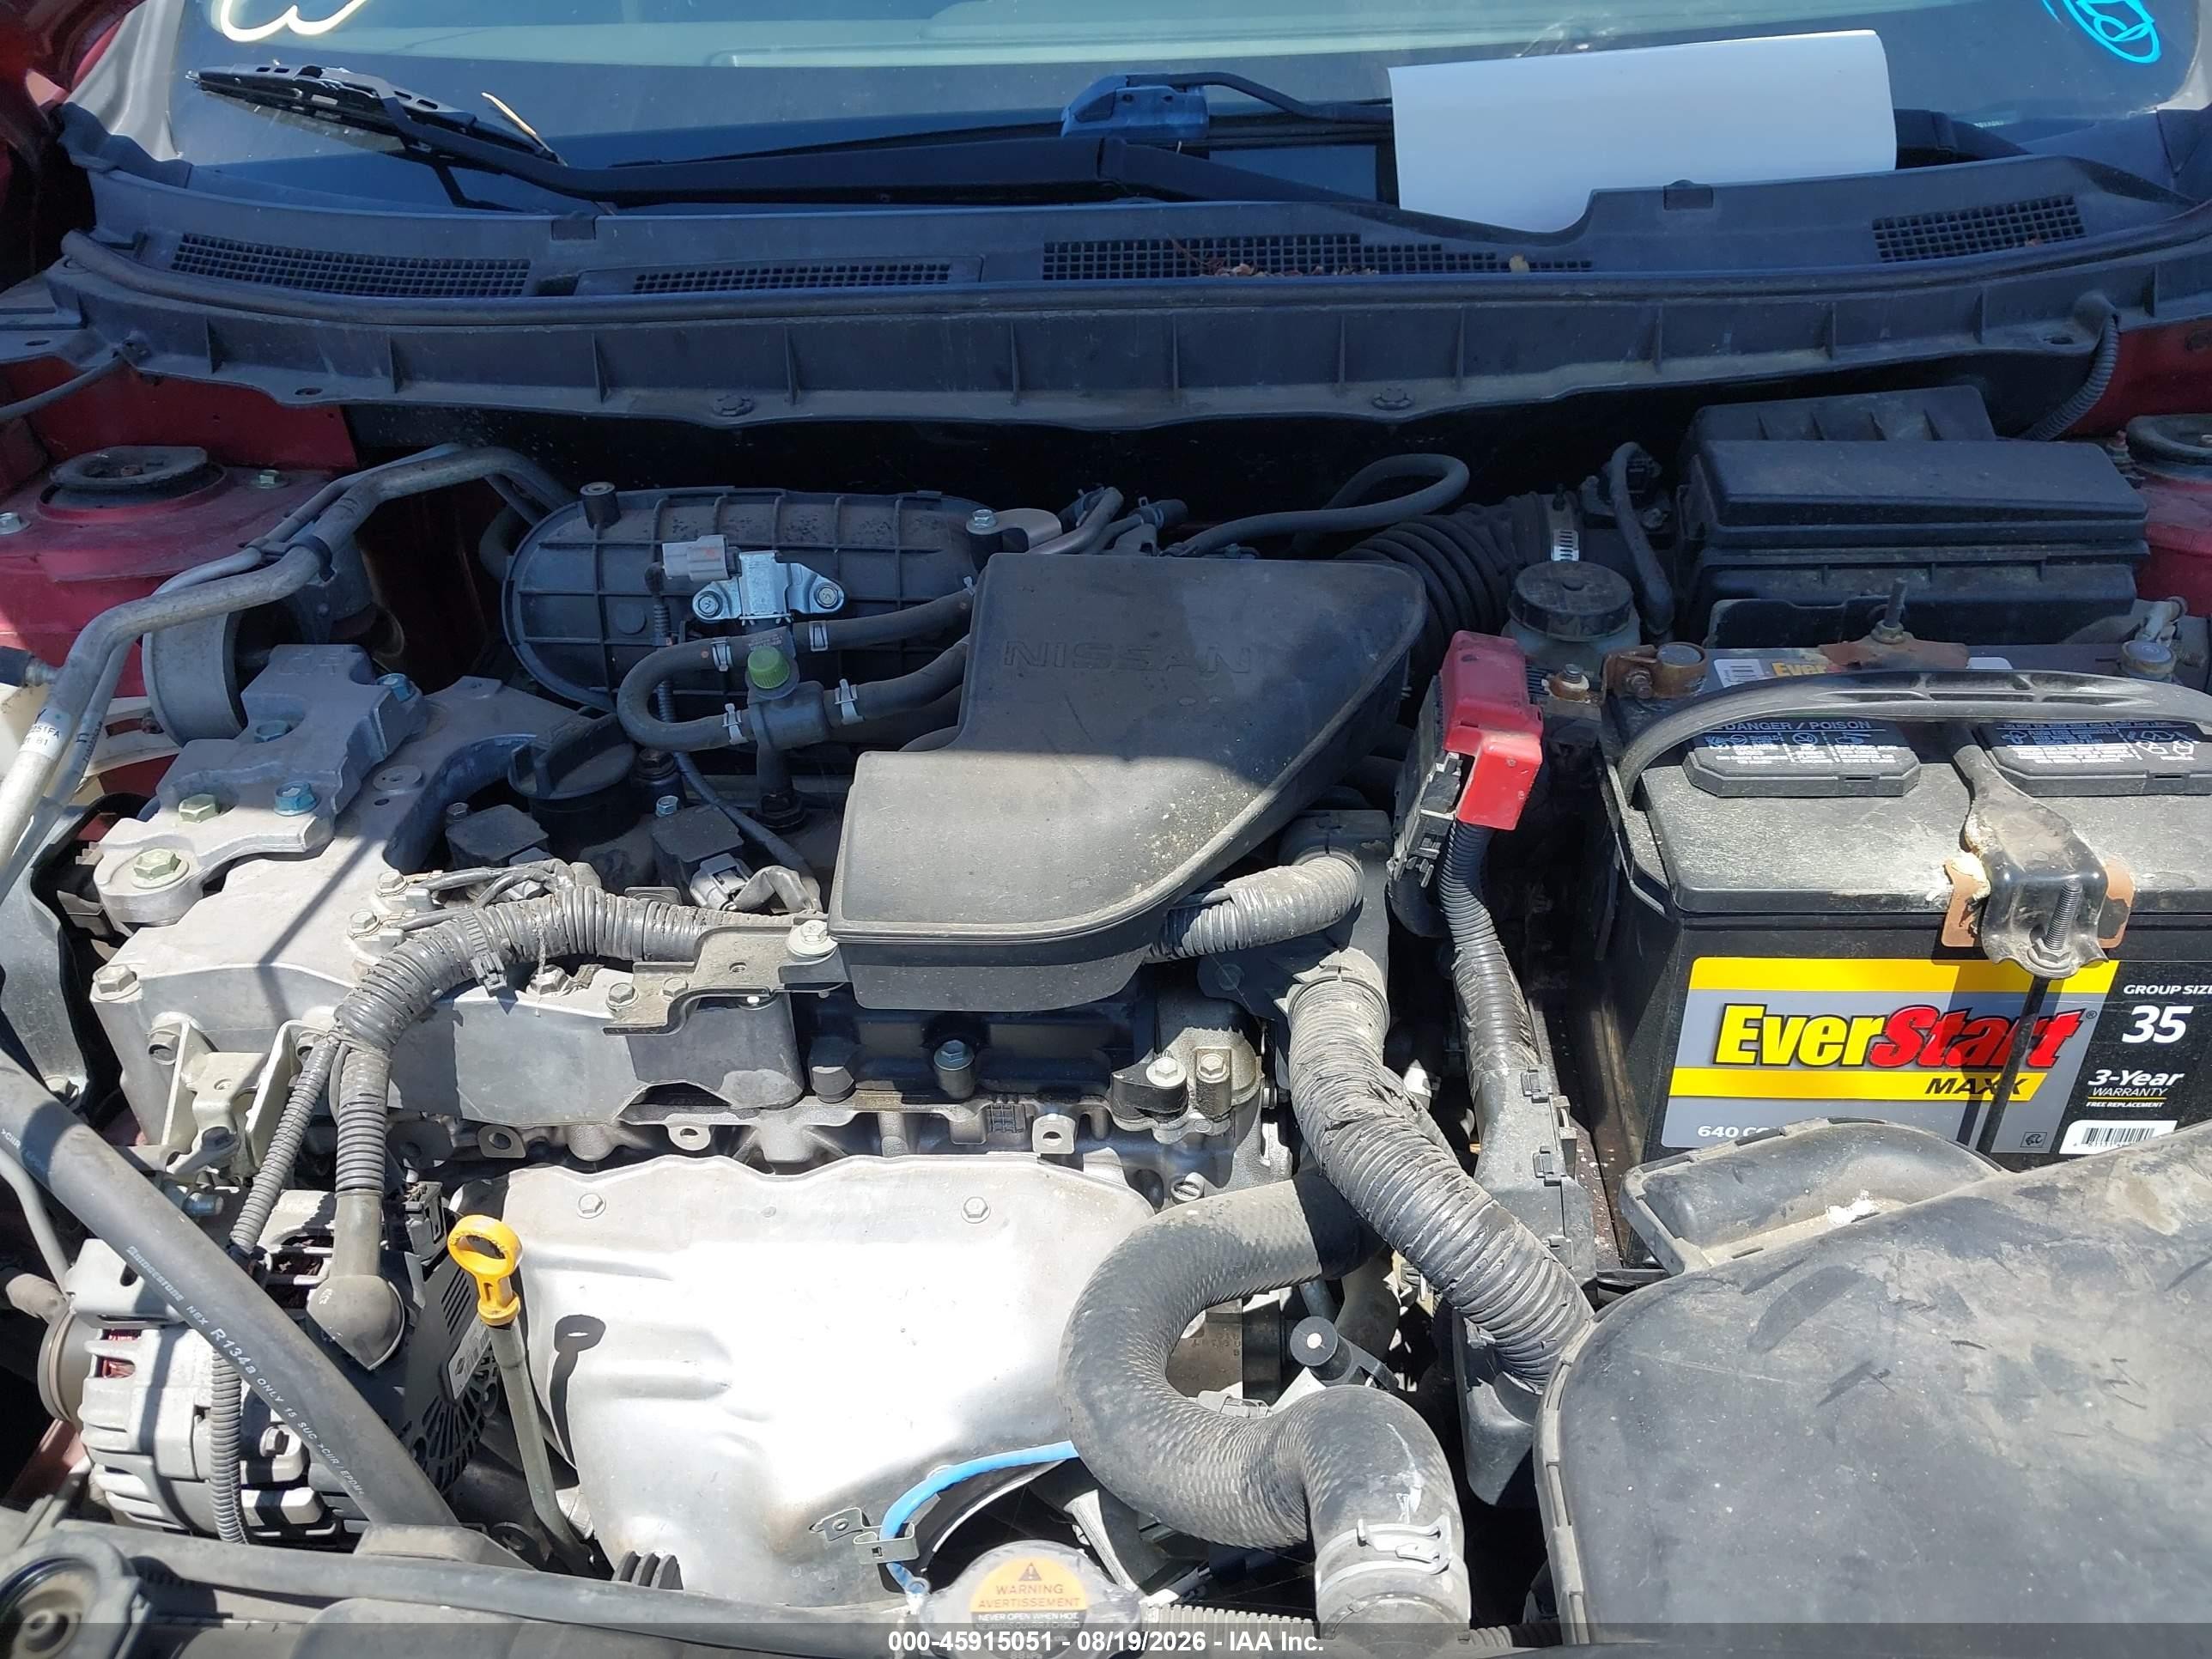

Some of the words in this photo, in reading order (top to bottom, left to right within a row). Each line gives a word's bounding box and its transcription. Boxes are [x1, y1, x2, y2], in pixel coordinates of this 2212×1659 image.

[1003, 640, 1254, 674] NISSAN
[1808, 720, 1872, 730] POISON
[2123, 984, 2182, 995] GROUP
[2122, 1004, 2194, 1043] 35
[2087, 1068, 2185, 1087] 3-Year
[2092, 1087, 2169, 1097] WARRANTY
[1697, 1125, 1740, 1139] 640
[185, 1305, 210, 1326] NEX
[210, 1328, 256, 1375] R134a
[257, 1377, 285, 1402] ONLY
[284, 1407, 297, 1419] 15
[297, 1421, 319, 1442] SUC
[994, 1583, 1065, 1595] WARNING
[977, 1598, 1081, 1608] AVERTISSEMENT
